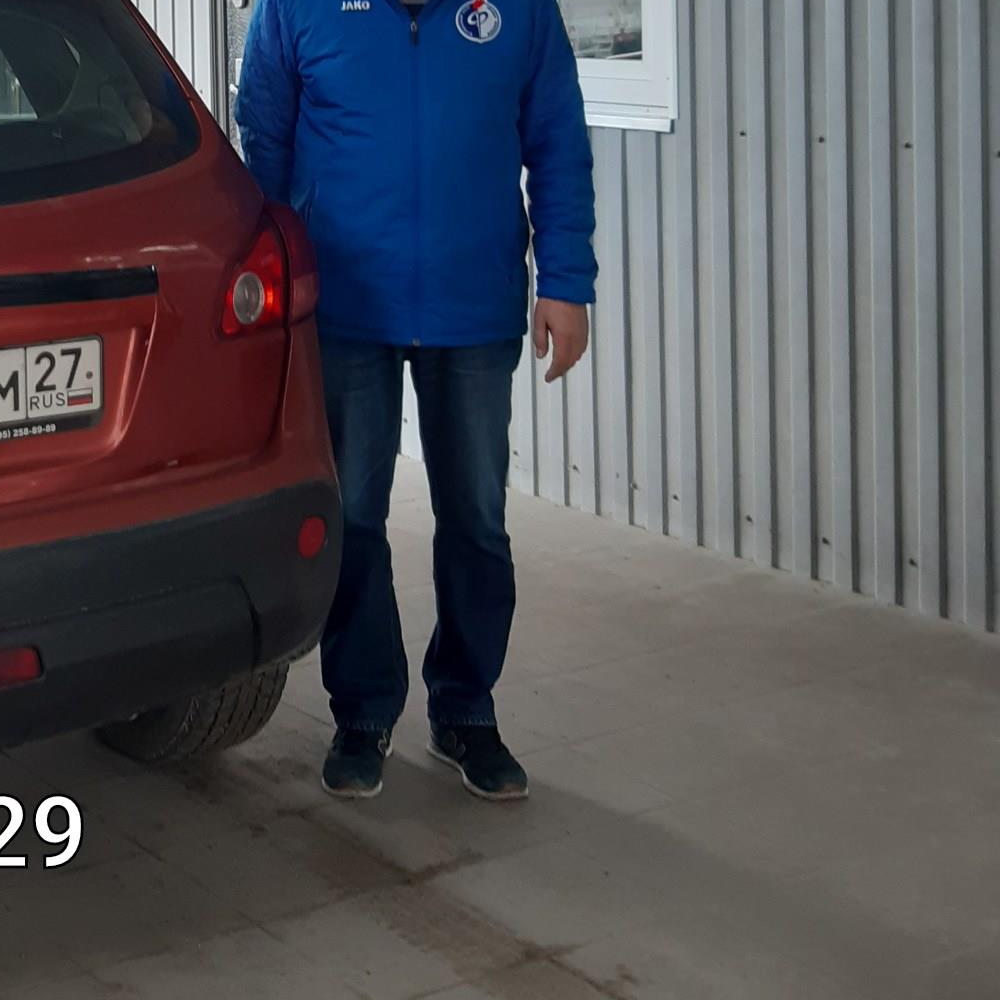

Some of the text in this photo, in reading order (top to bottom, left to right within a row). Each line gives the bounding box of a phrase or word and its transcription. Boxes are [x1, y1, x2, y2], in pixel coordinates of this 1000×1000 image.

[340, 0, 371, 11] JAKO
[35, 347, 82, 393] 27
[30, 394, 67, 412] RUS
